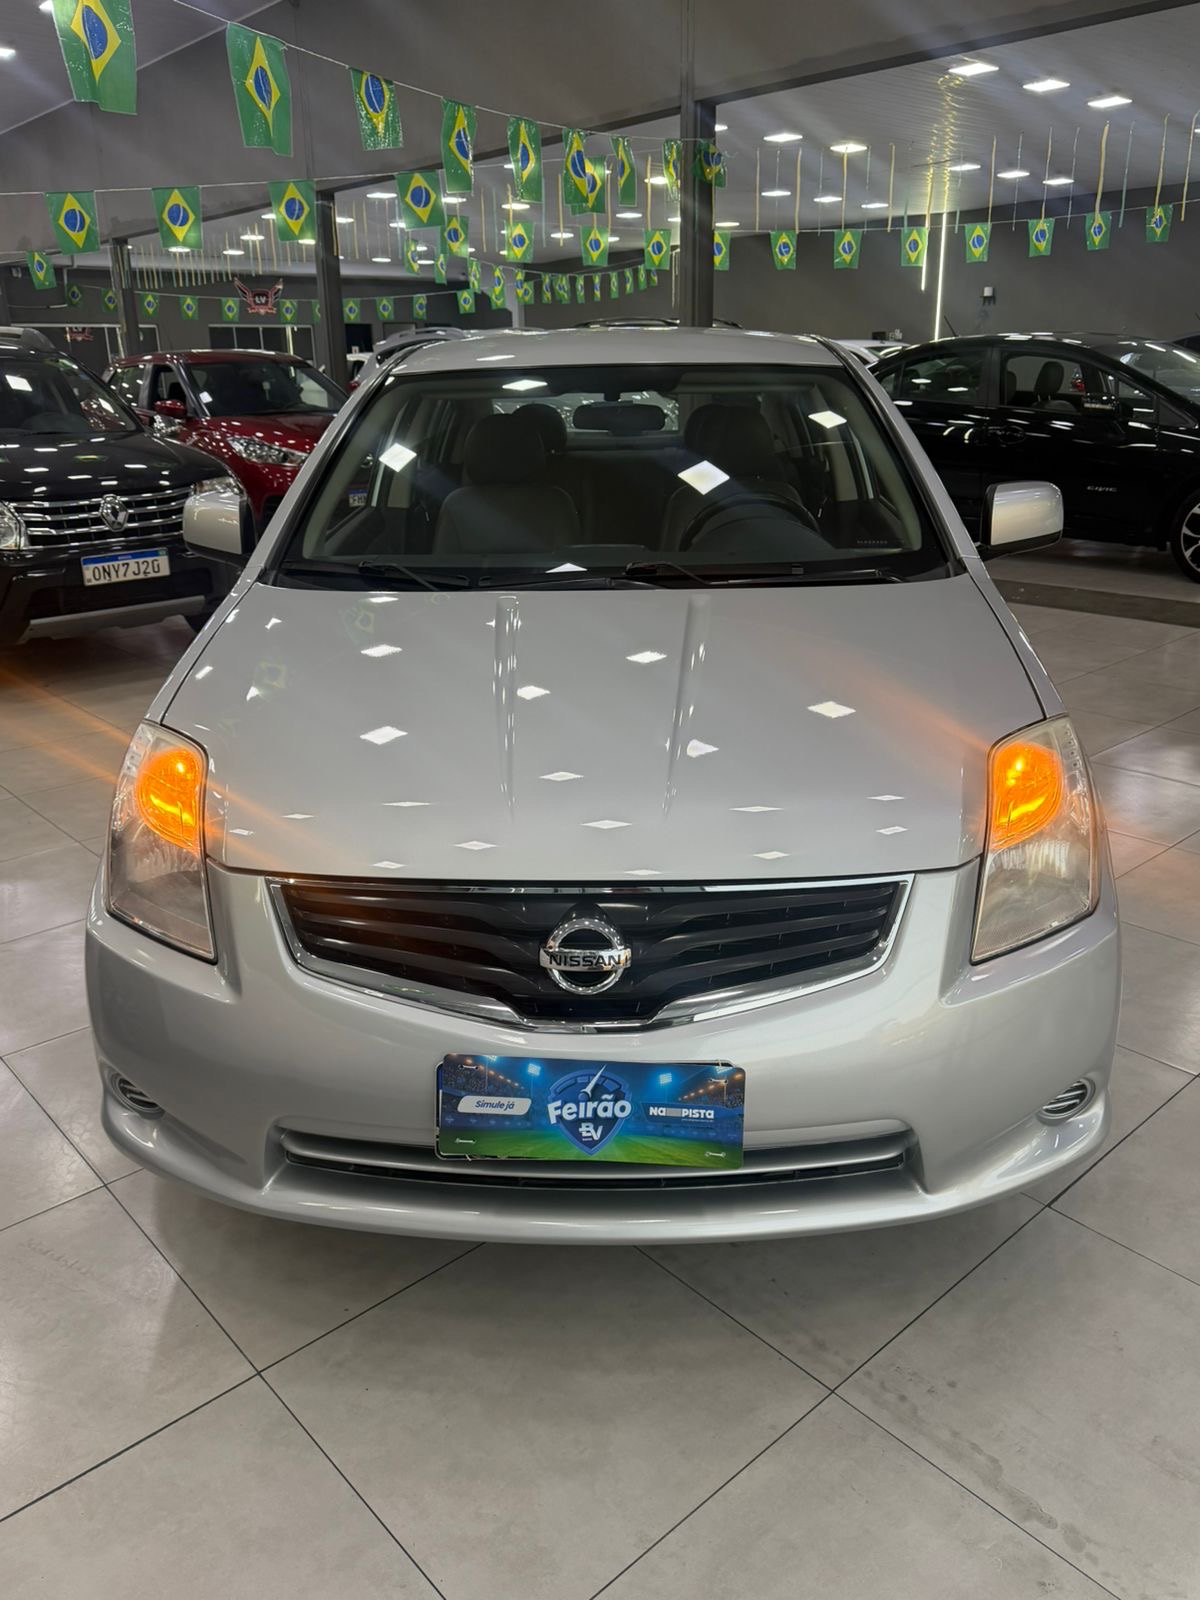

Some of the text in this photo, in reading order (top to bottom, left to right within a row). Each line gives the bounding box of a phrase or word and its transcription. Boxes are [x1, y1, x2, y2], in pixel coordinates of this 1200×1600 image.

[92, 558, 160, 581] ONY7J20
[549, 954, 621, 967] NISSAN
[475, 1100, 515, 1111] Simule já
[547, 1094, 632, 1124] Feirão
